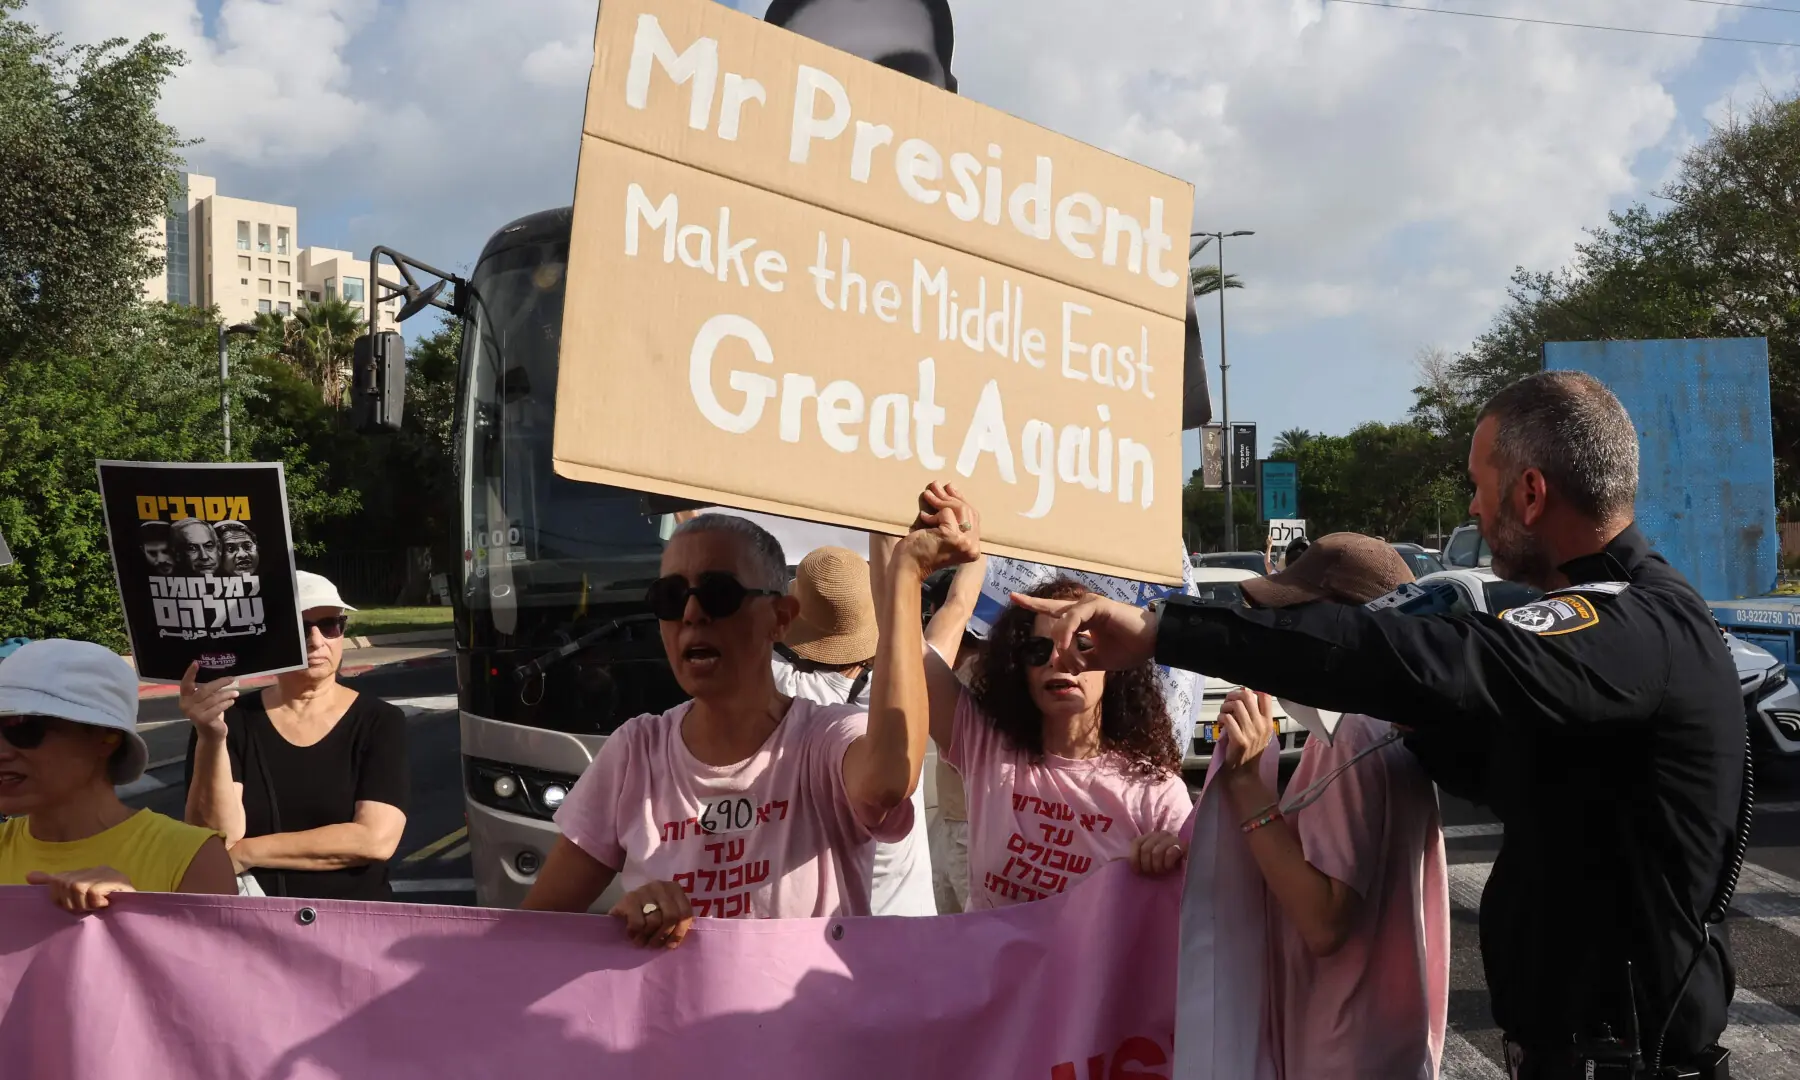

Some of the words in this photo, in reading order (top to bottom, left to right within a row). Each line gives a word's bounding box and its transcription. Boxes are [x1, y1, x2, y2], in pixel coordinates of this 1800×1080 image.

[626, 13, 766, 140] Mr
[790, 65, 1179, 287] President
[625, 183, 788, 292] Make
[808, 231, 901, 323] the
[911, 258, 1046, 369] Middle
[1061, 302, 1155, 400] East
[689, 314, 946, 471] Great
[956, 379, 1154, 519] Again
[136, 495, 251, 520] מסרבים
[148, 572, 261, 598] למלחמה
[152, 594, 265, 628] שלהם
[1736, 610, 1783, 624] 03-9222750
[700, 798, 752, 831] 690
[756, 800, 789, 825] לא
[1079, 814, 1114, 832] לא
[1039, 822, 1074, 847] עד
[704, 838, 745, 864] עד
[1007, 832, 1092, 874] שכולם
[673, 860, 770, 893] שכולם
[1002, 856, 1068, 894] וכולן
[691, 892, 750, 918] וכול
